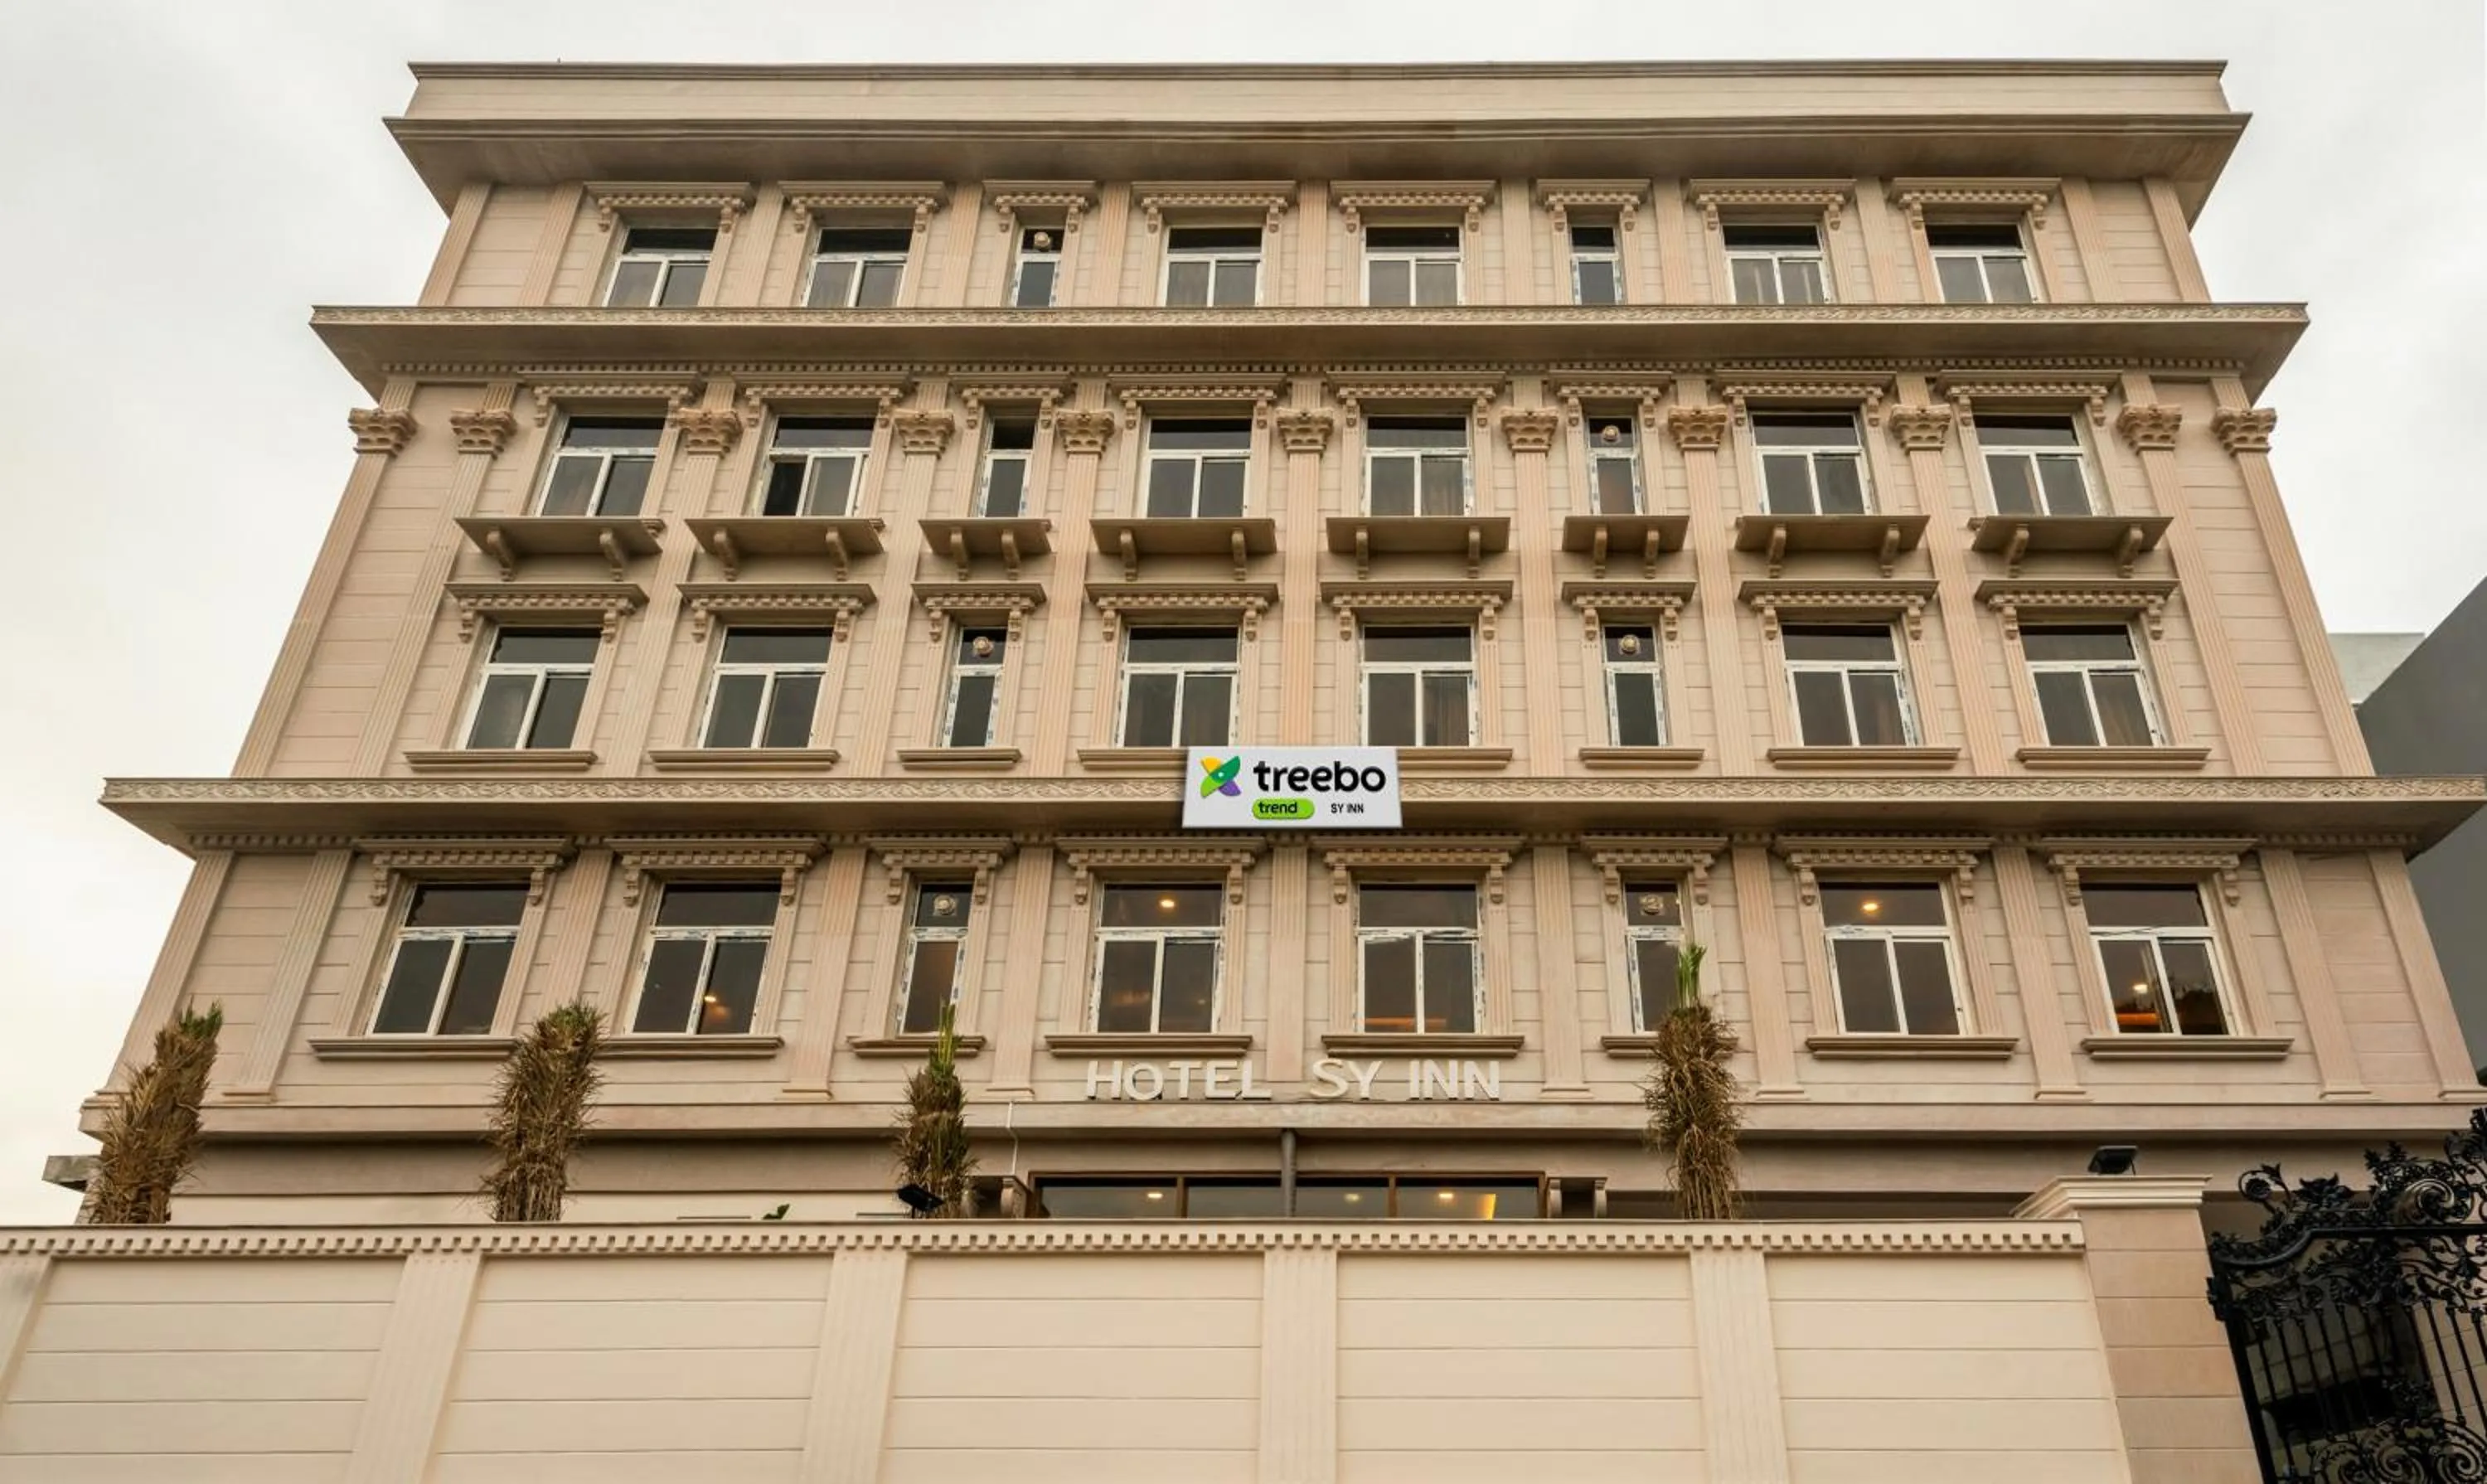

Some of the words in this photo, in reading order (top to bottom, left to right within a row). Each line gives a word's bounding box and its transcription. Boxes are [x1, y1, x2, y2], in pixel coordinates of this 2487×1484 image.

[1253, 760, 1386, 793] treebo
[1258, 802, 1298, 814] trend
[1331, 803, 1344, 814] SY
[1347, 803, 1365, 813] INN
[1086, 1060, 1273, 1101] HOTEL
[1310, 1057, 1384, 1099] SY
[1409, 1059, 1500, 1101] INN
